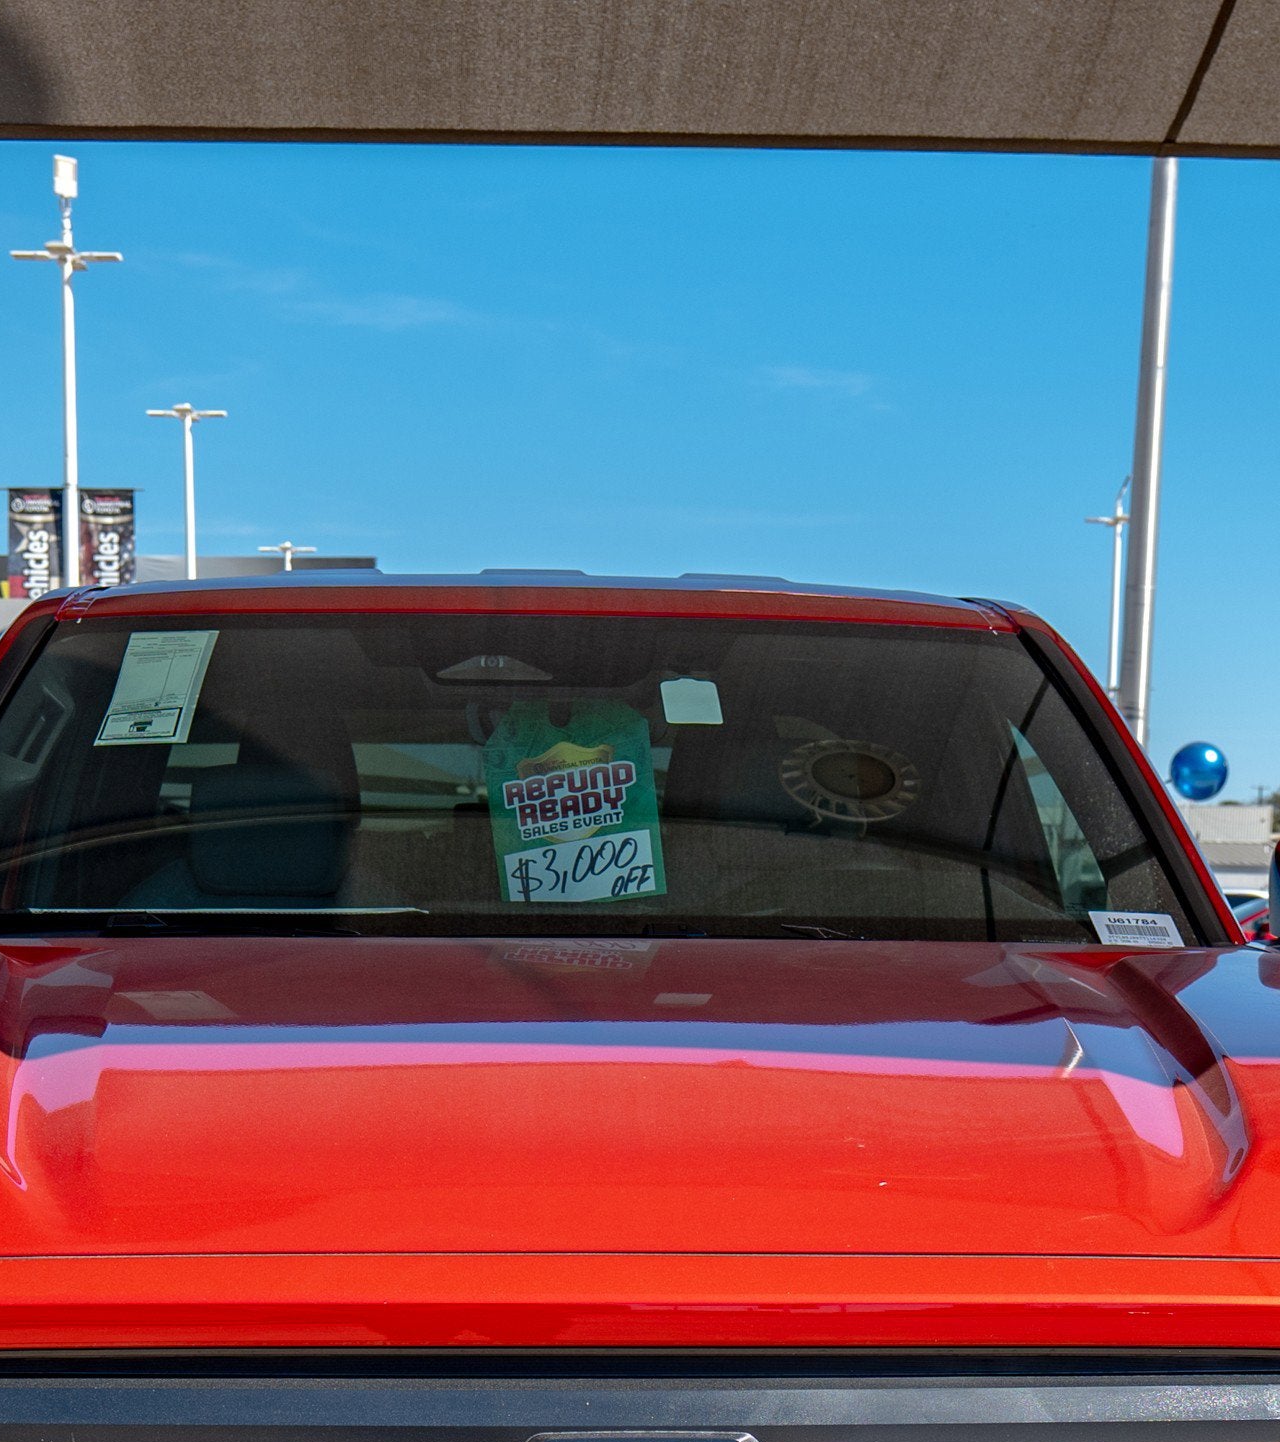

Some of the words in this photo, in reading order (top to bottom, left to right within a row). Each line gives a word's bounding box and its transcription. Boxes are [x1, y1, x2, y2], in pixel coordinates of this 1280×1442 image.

[505, 763, 634, 806] REFUND
[518, 787, 624, 827] READY
[523, 821, 568, 839] SALES
[573, 812, 622, 829] EVENT
[511, 838, 638, 902] $3,000
[611, 864, 653, 898] OFF
